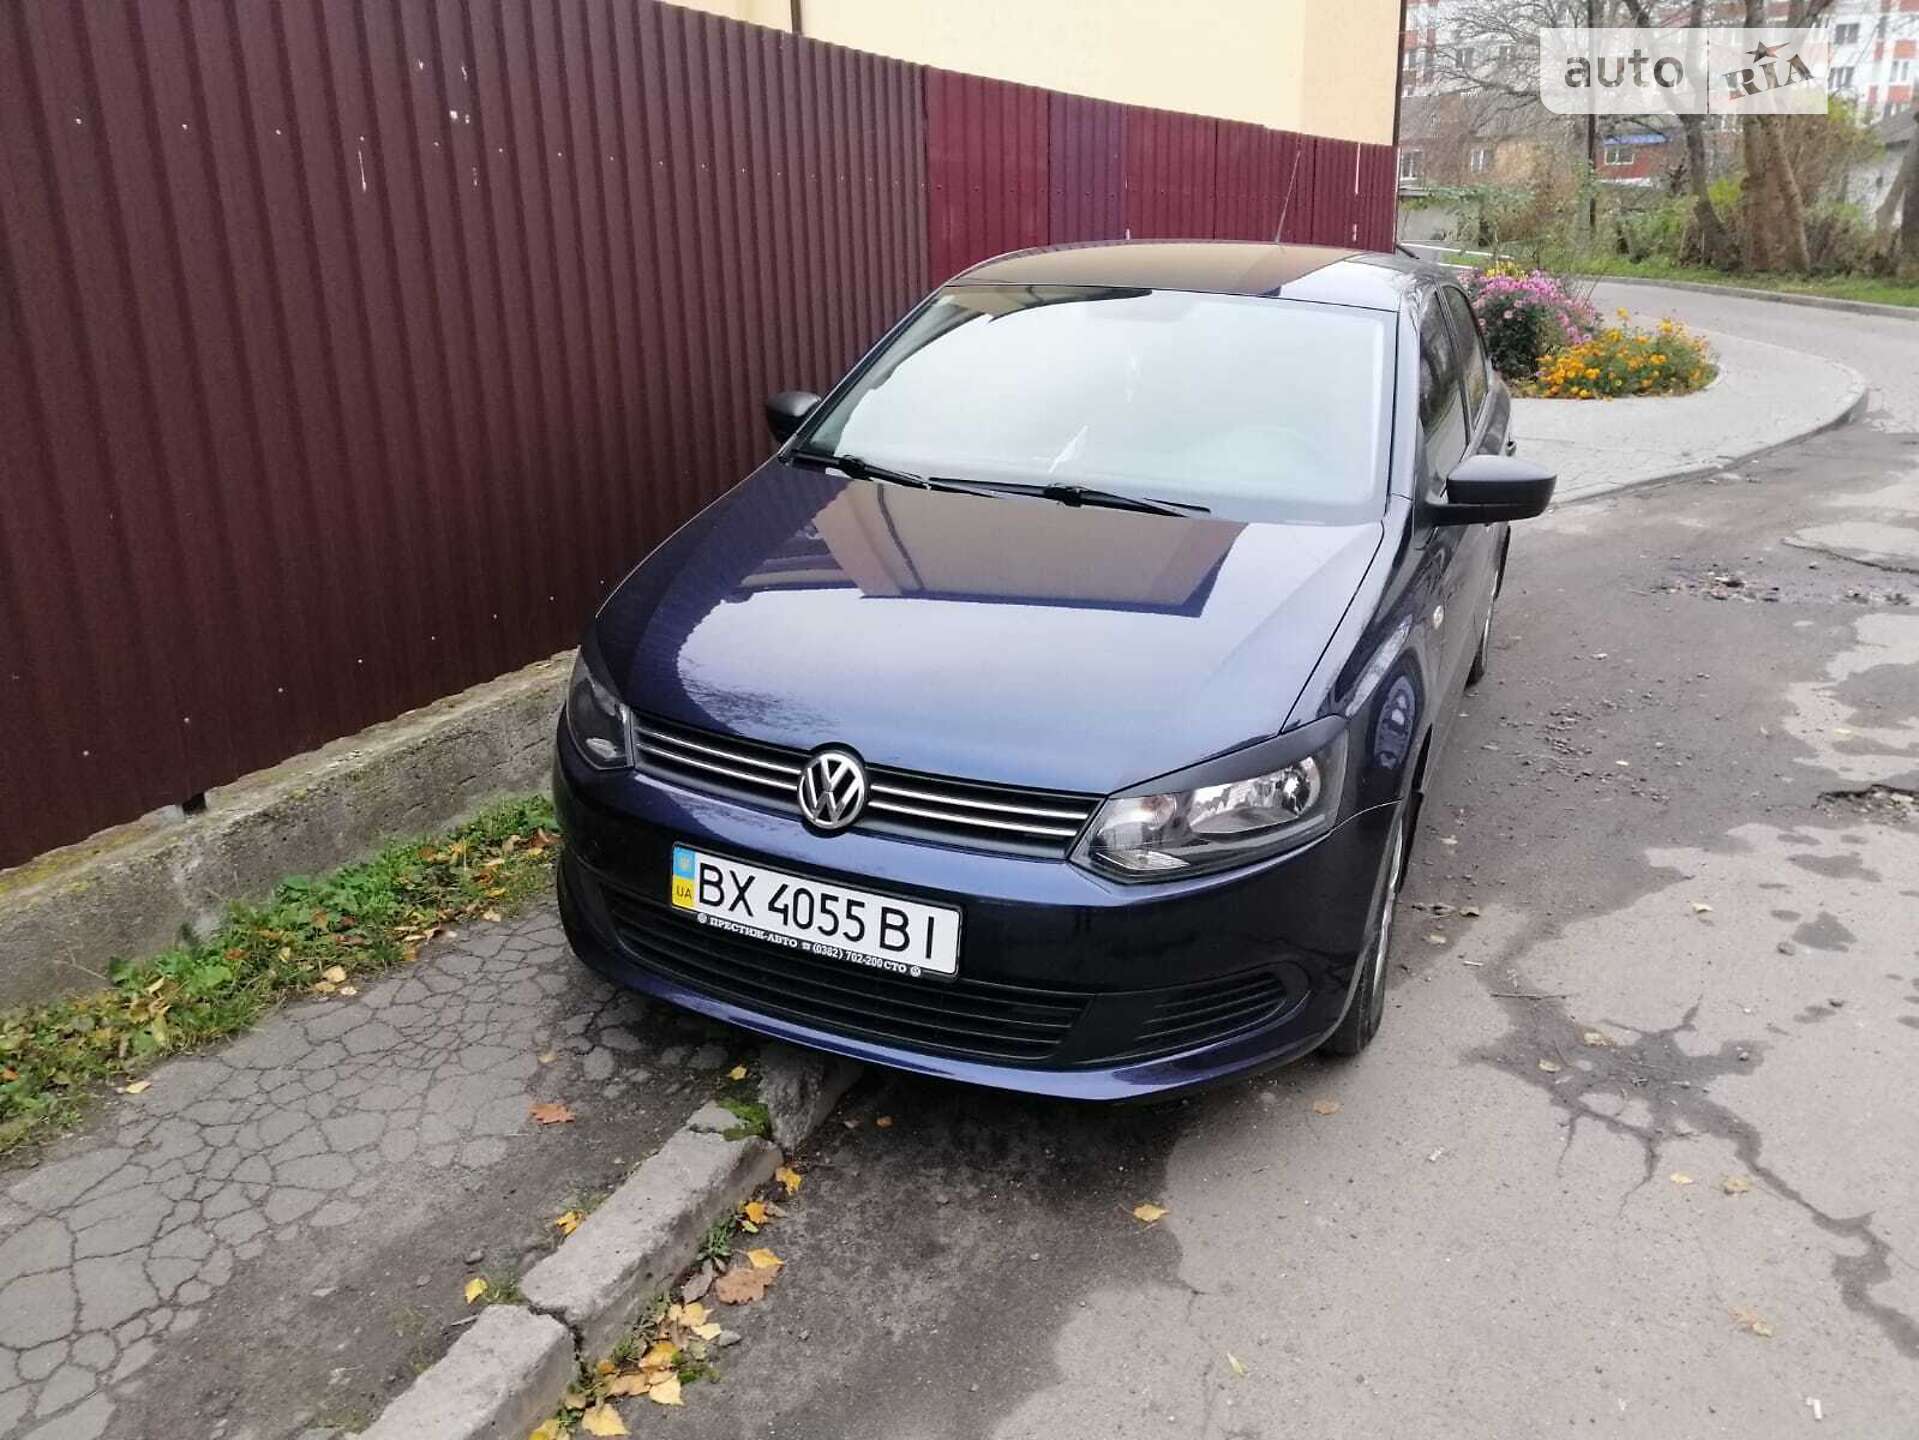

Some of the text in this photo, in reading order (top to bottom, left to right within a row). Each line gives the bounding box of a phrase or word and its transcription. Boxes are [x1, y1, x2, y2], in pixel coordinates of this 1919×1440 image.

[675, 886, 693, 900] UA
[699, 862, 756, 917] BX
[767, 883, 866, 943] 4055
